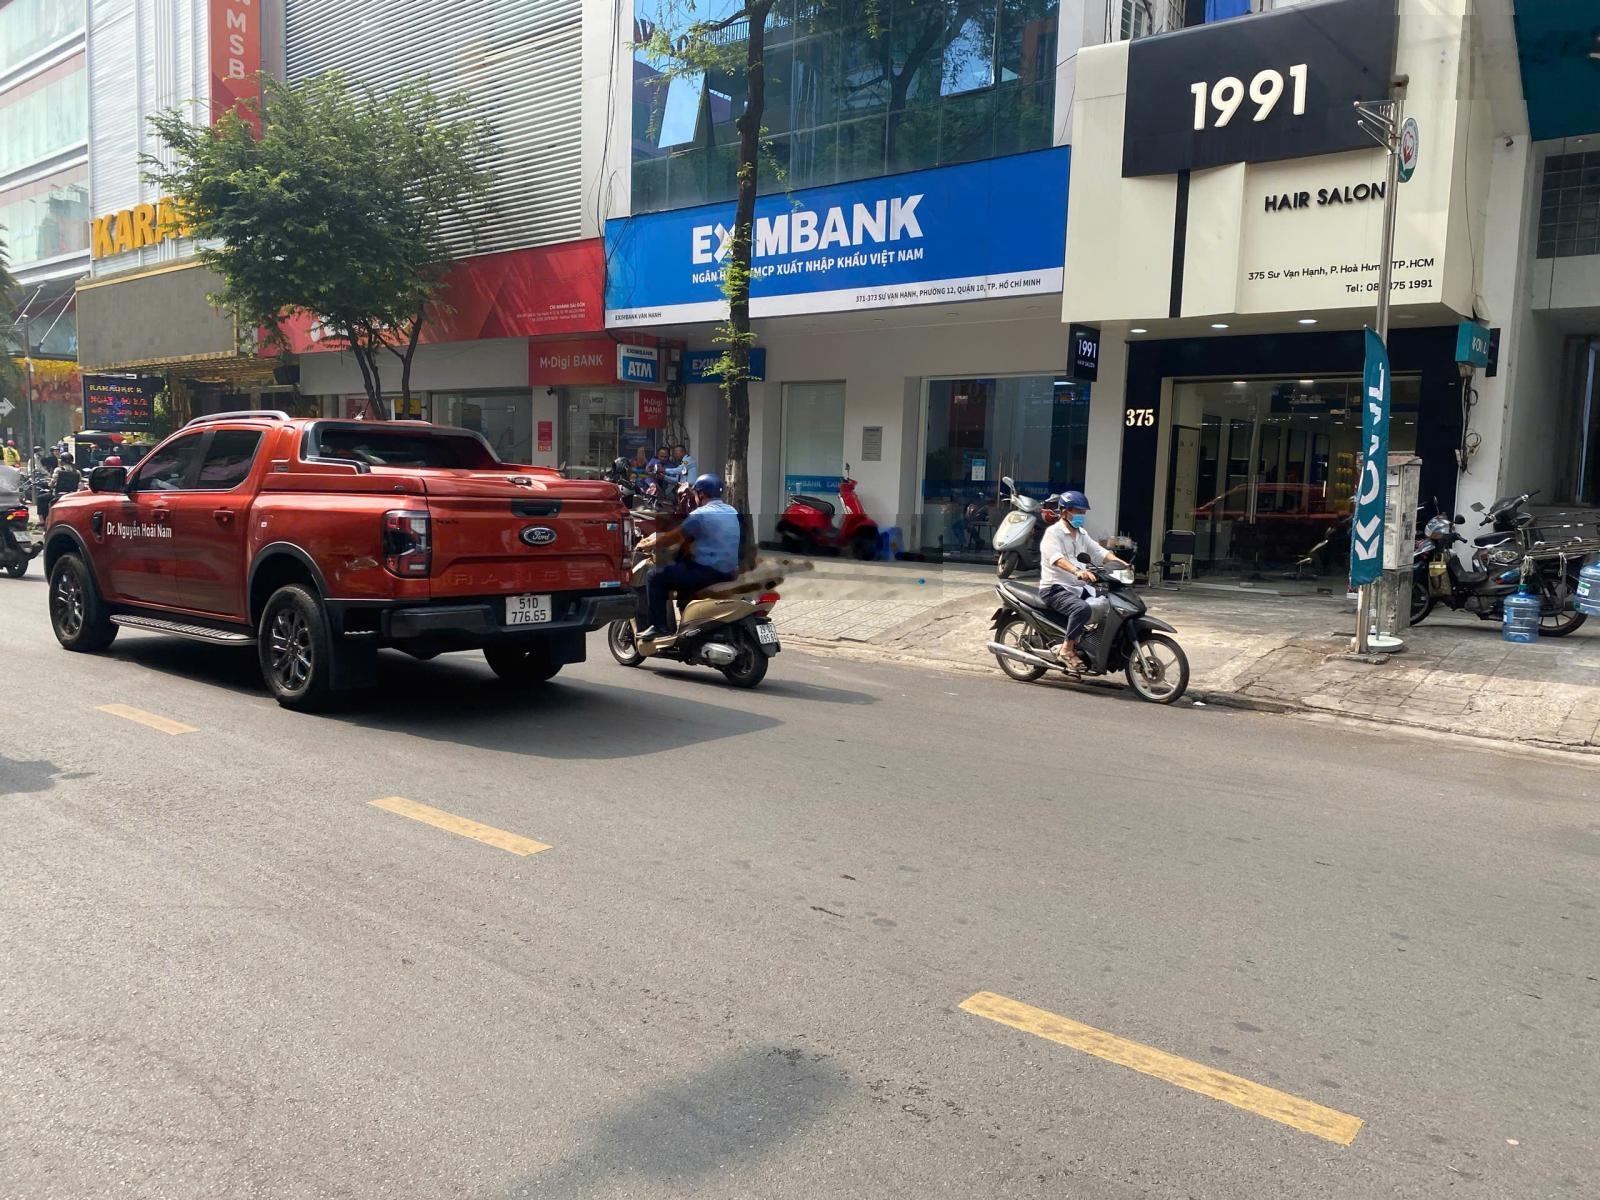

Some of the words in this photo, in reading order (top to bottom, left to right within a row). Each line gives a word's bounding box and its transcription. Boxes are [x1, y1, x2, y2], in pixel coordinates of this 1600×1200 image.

[226, 8, 246, 79] MSB
[1190, 63, 1308, 131] 1991
[1264, 191, 1310, 212] HAIR
[1316, 181, 1386, 206] SALON
[692, 194, 924, 265] EXMBANK
[692, 270, 718, 284] NGÂN
[776, 259, 804, 275] XUẤT
[805, 256, 834, 273] NHẬP
[869, 250, 895, 267] VIỆT
[897, 248, 924, 262] NAM
[1248, 271, 1265, 280] 375
[1267, 270, 1281, 279] Sư
[1283, 269, 1300, 279] Vạn
[1302, 266, 1328, 278] Hạnh,
[1330, 265, 1339, 275] P.
[1340, 264, 1359, 274] Hoà
[1361, 262, 1381, 272] Hưn
[1392, 258, 1434, 269] TP.HCM
[946, 285, 957, 294] 12,
[976, 282, 987, 292] 10,
[987, 282, 998, 291] TP.
[1010, 278, 1022, 288] CHÍ
[1023, 277, 1041, 287] MINH
[1345, 284, 1364, 293] Tel:
[1408, 279, 1433, 289] 1991
[1078, 339, 1097, 359] 1991
[573, 353, 604, 368] BANK
[627, 361, 654, 378] ATM
[644, 406, 663, 414] BANK
[1125, 408, 1155, 427] 375
[106, 521, 117, 535] Dr.
[157, 523, 172, 538] Nam
[532, 530, 551, 540] Ford
[519, 598, 539, 609] 51D
[512, 610, 547, 623] 776.65
